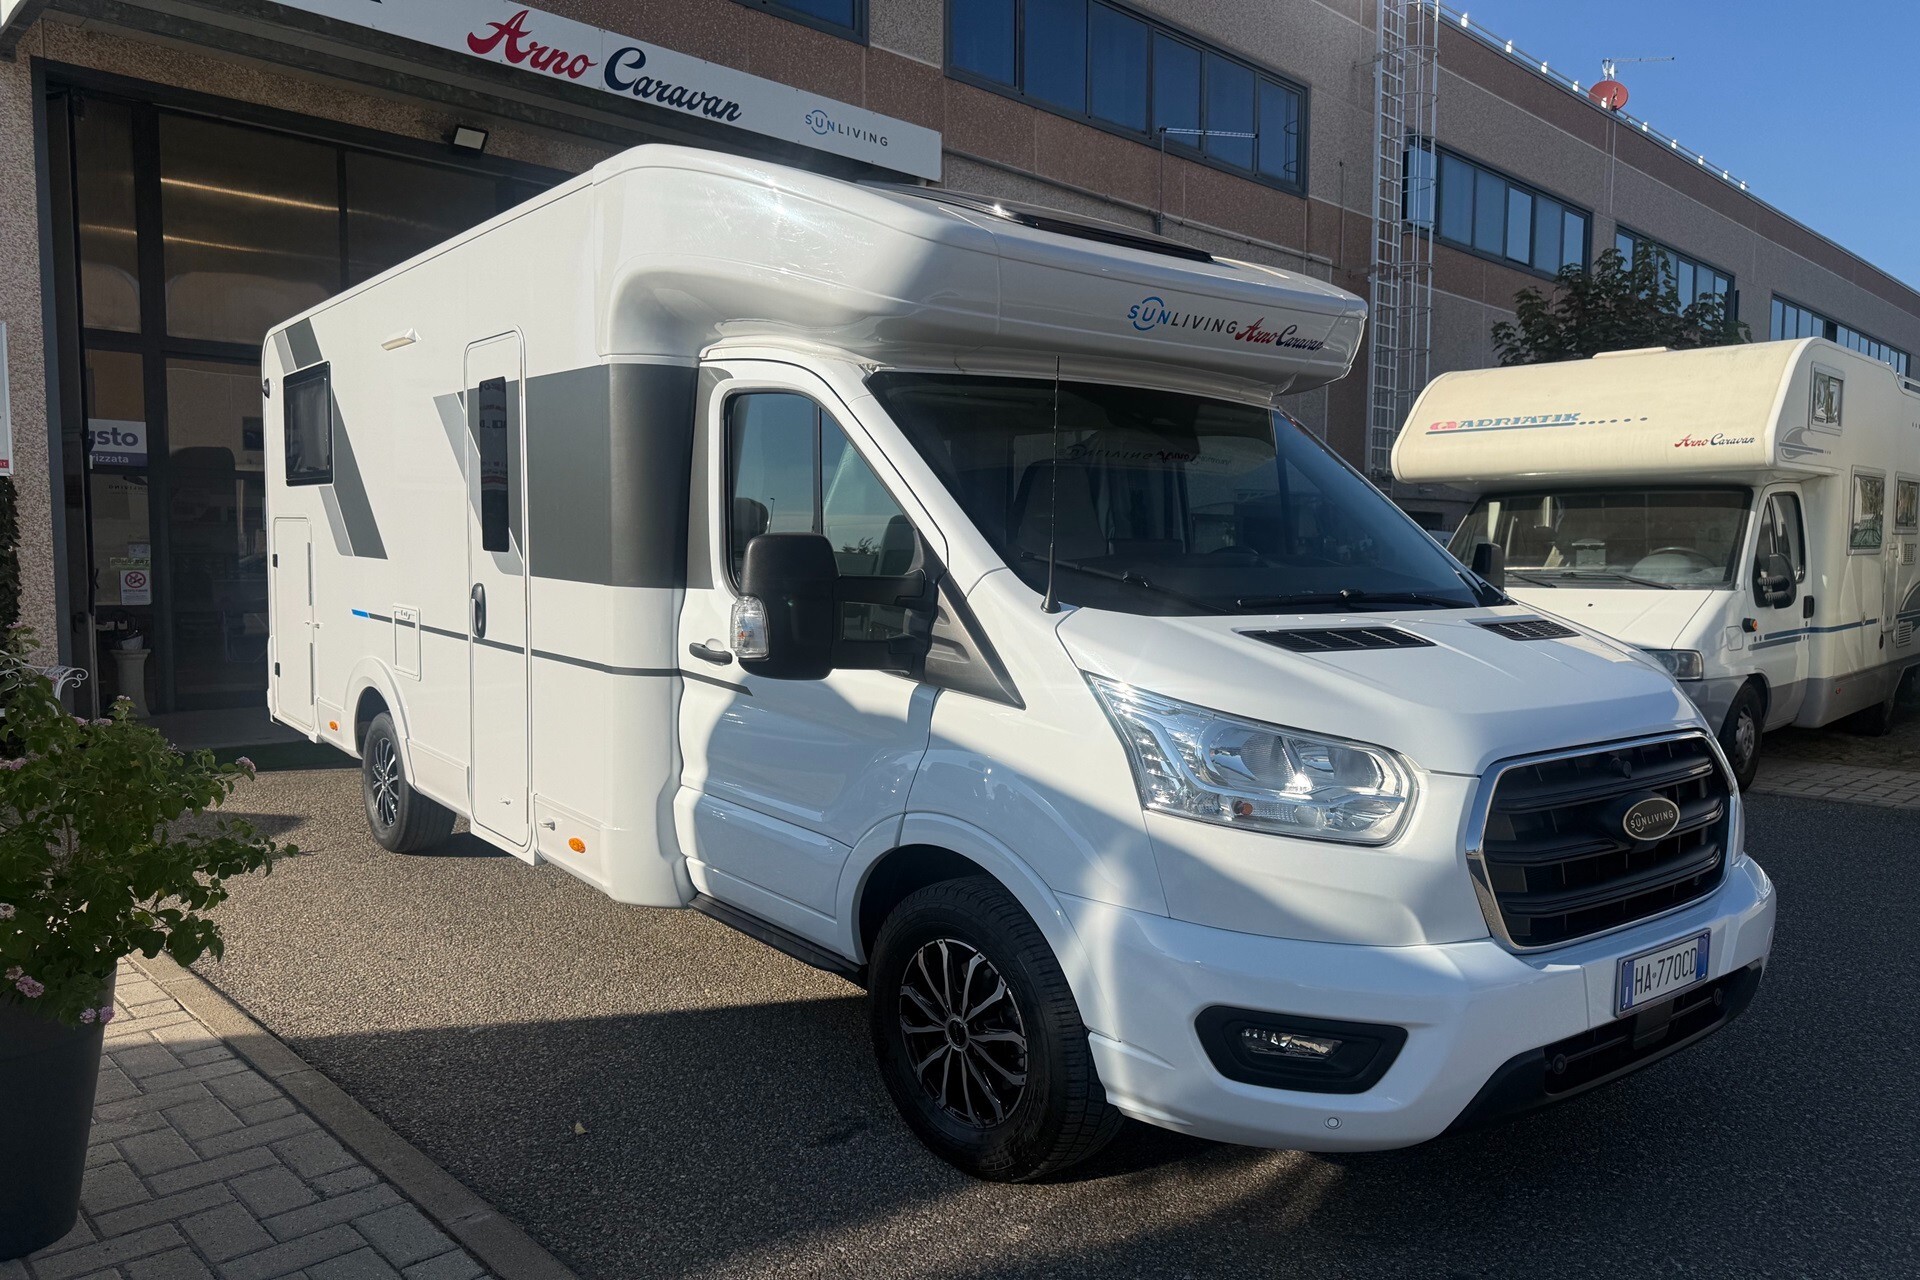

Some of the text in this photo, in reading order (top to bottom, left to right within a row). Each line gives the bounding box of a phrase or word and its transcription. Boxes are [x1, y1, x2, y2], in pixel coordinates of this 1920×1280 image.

[467, 10, 742, 121] Arno Caravan
[805, 110, 889, 147] SUNLIVING
[1127, 297, 1238, 334] SUNLIVING
[1234, 317, 1324, 352] Arno Caravan
[1458, 412, 1582, 430] ADRIATIK
[90, 427, 139, 447] sto
[1674, 432, 1756, 448] Arno Caravan
[1630, 809, 1674, 833] SUNLIVING
